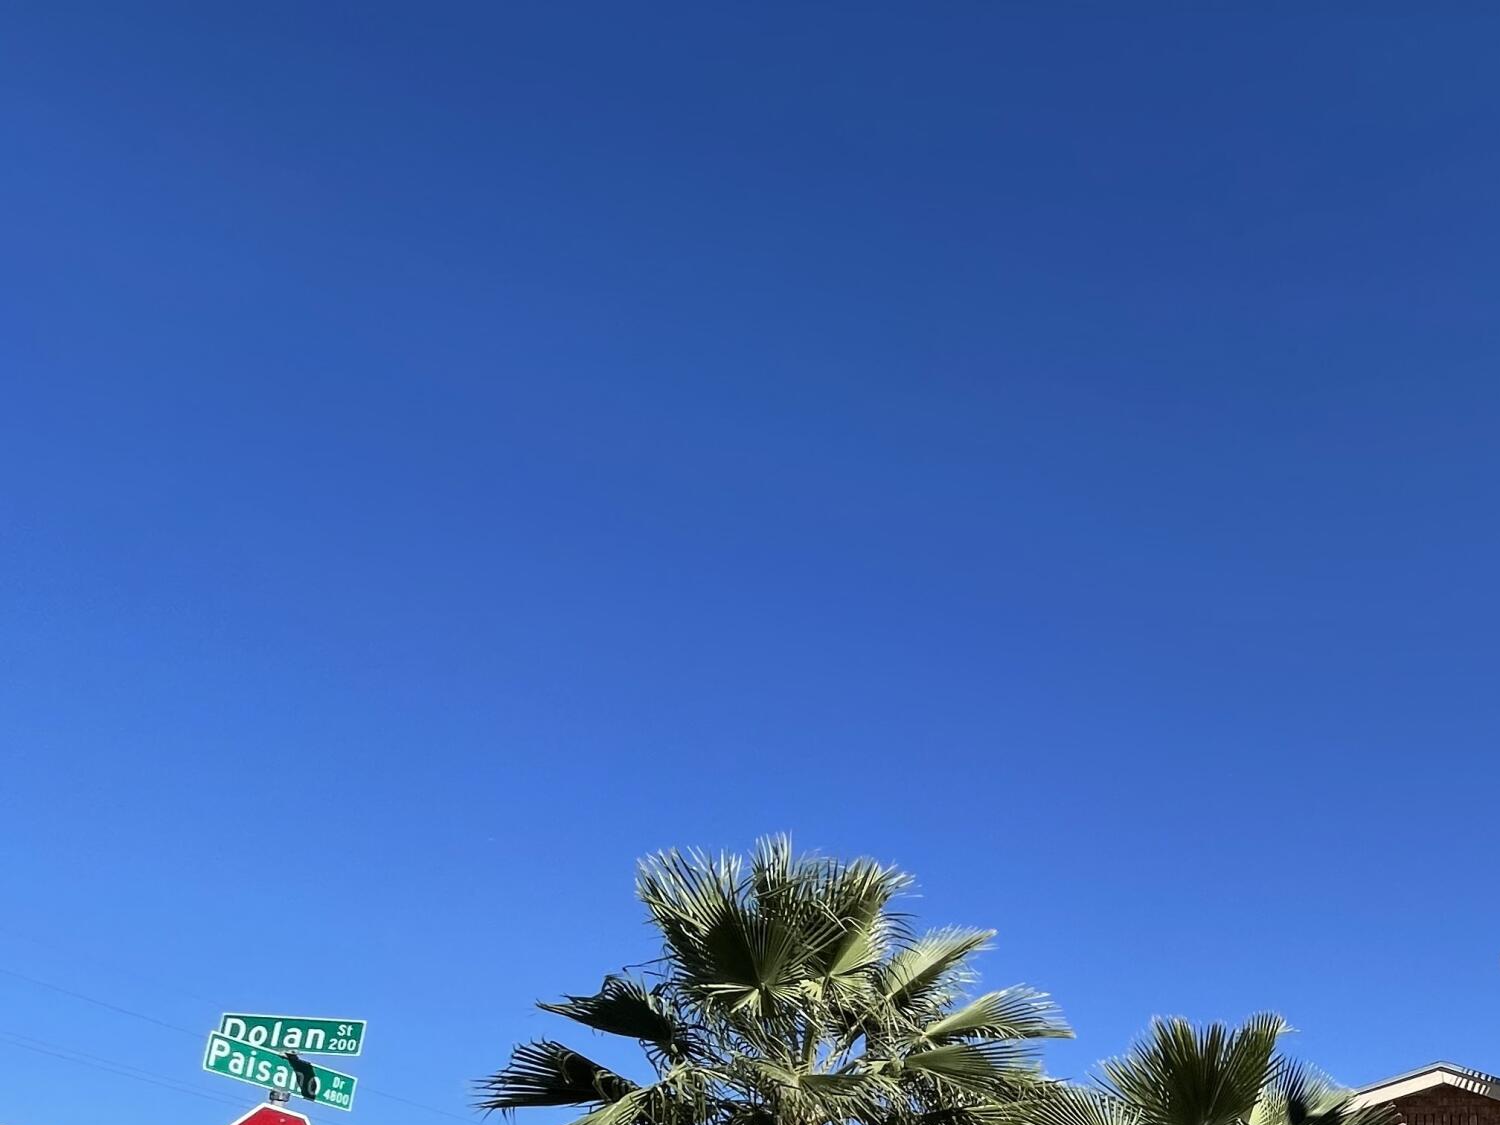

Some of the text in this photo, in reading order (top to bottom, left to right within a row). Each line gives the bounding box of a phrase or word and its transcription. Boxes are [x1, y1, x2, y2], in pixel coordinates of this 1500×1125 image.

[223, 1017, 354, 1050] Dolan St
[328, 1038, 357, 1051] 200
[208, 1038, 346, 1096] Paisano Dr
